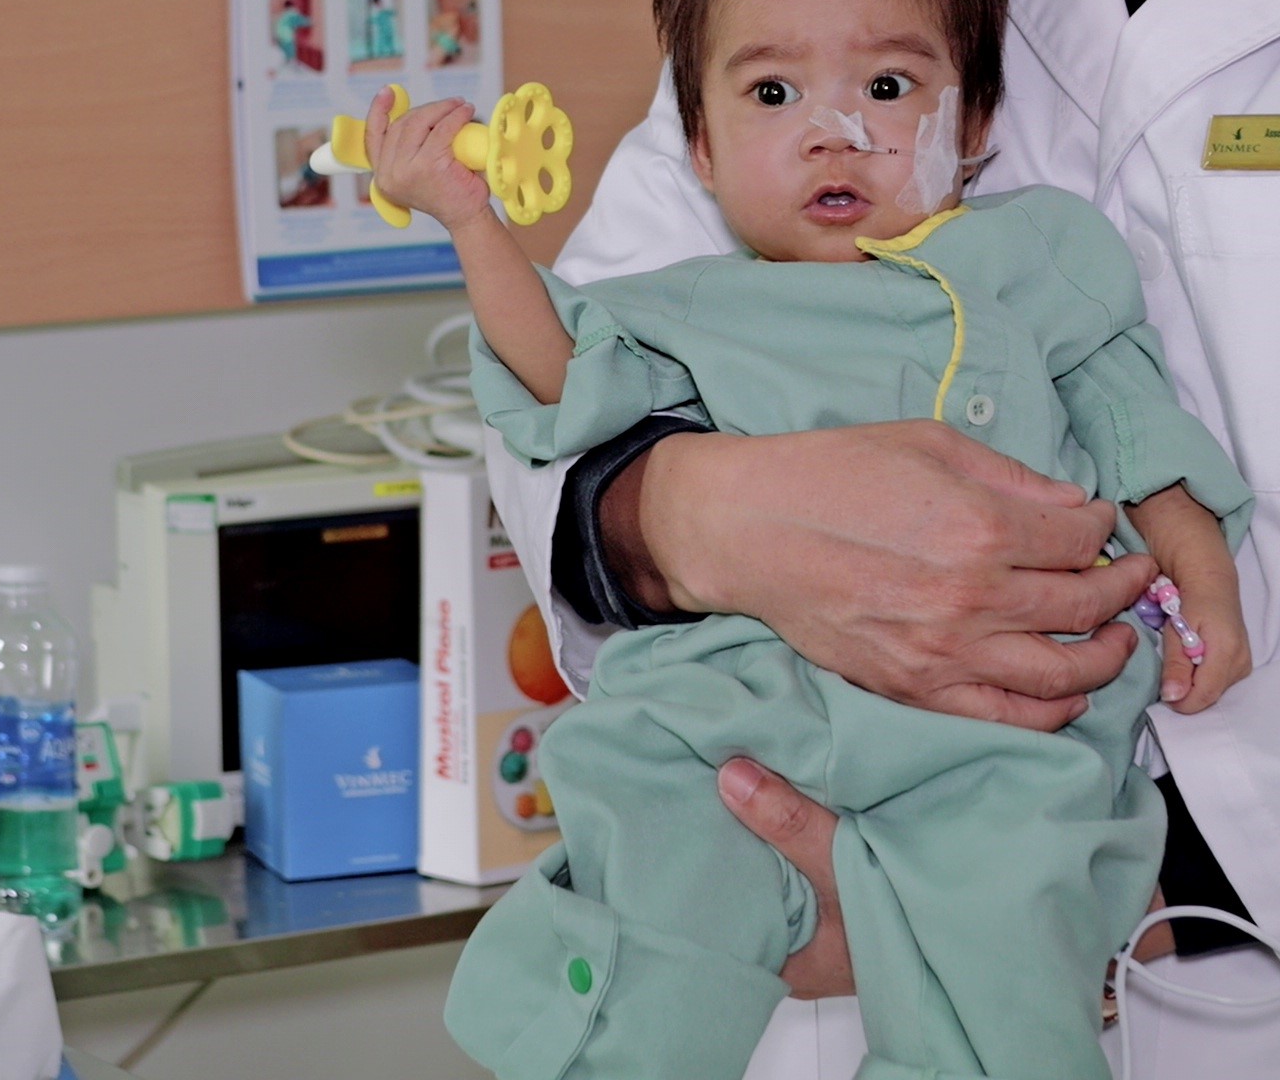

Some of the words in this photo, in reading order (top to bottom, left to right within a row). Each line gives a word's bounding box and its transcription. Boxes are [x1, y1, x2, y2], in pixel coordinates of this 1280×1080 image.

[1212, 143, 1261, 153] VINMEC
[434, 598, 452, 675] Piano
[435, 680, 453, 780] Musical
